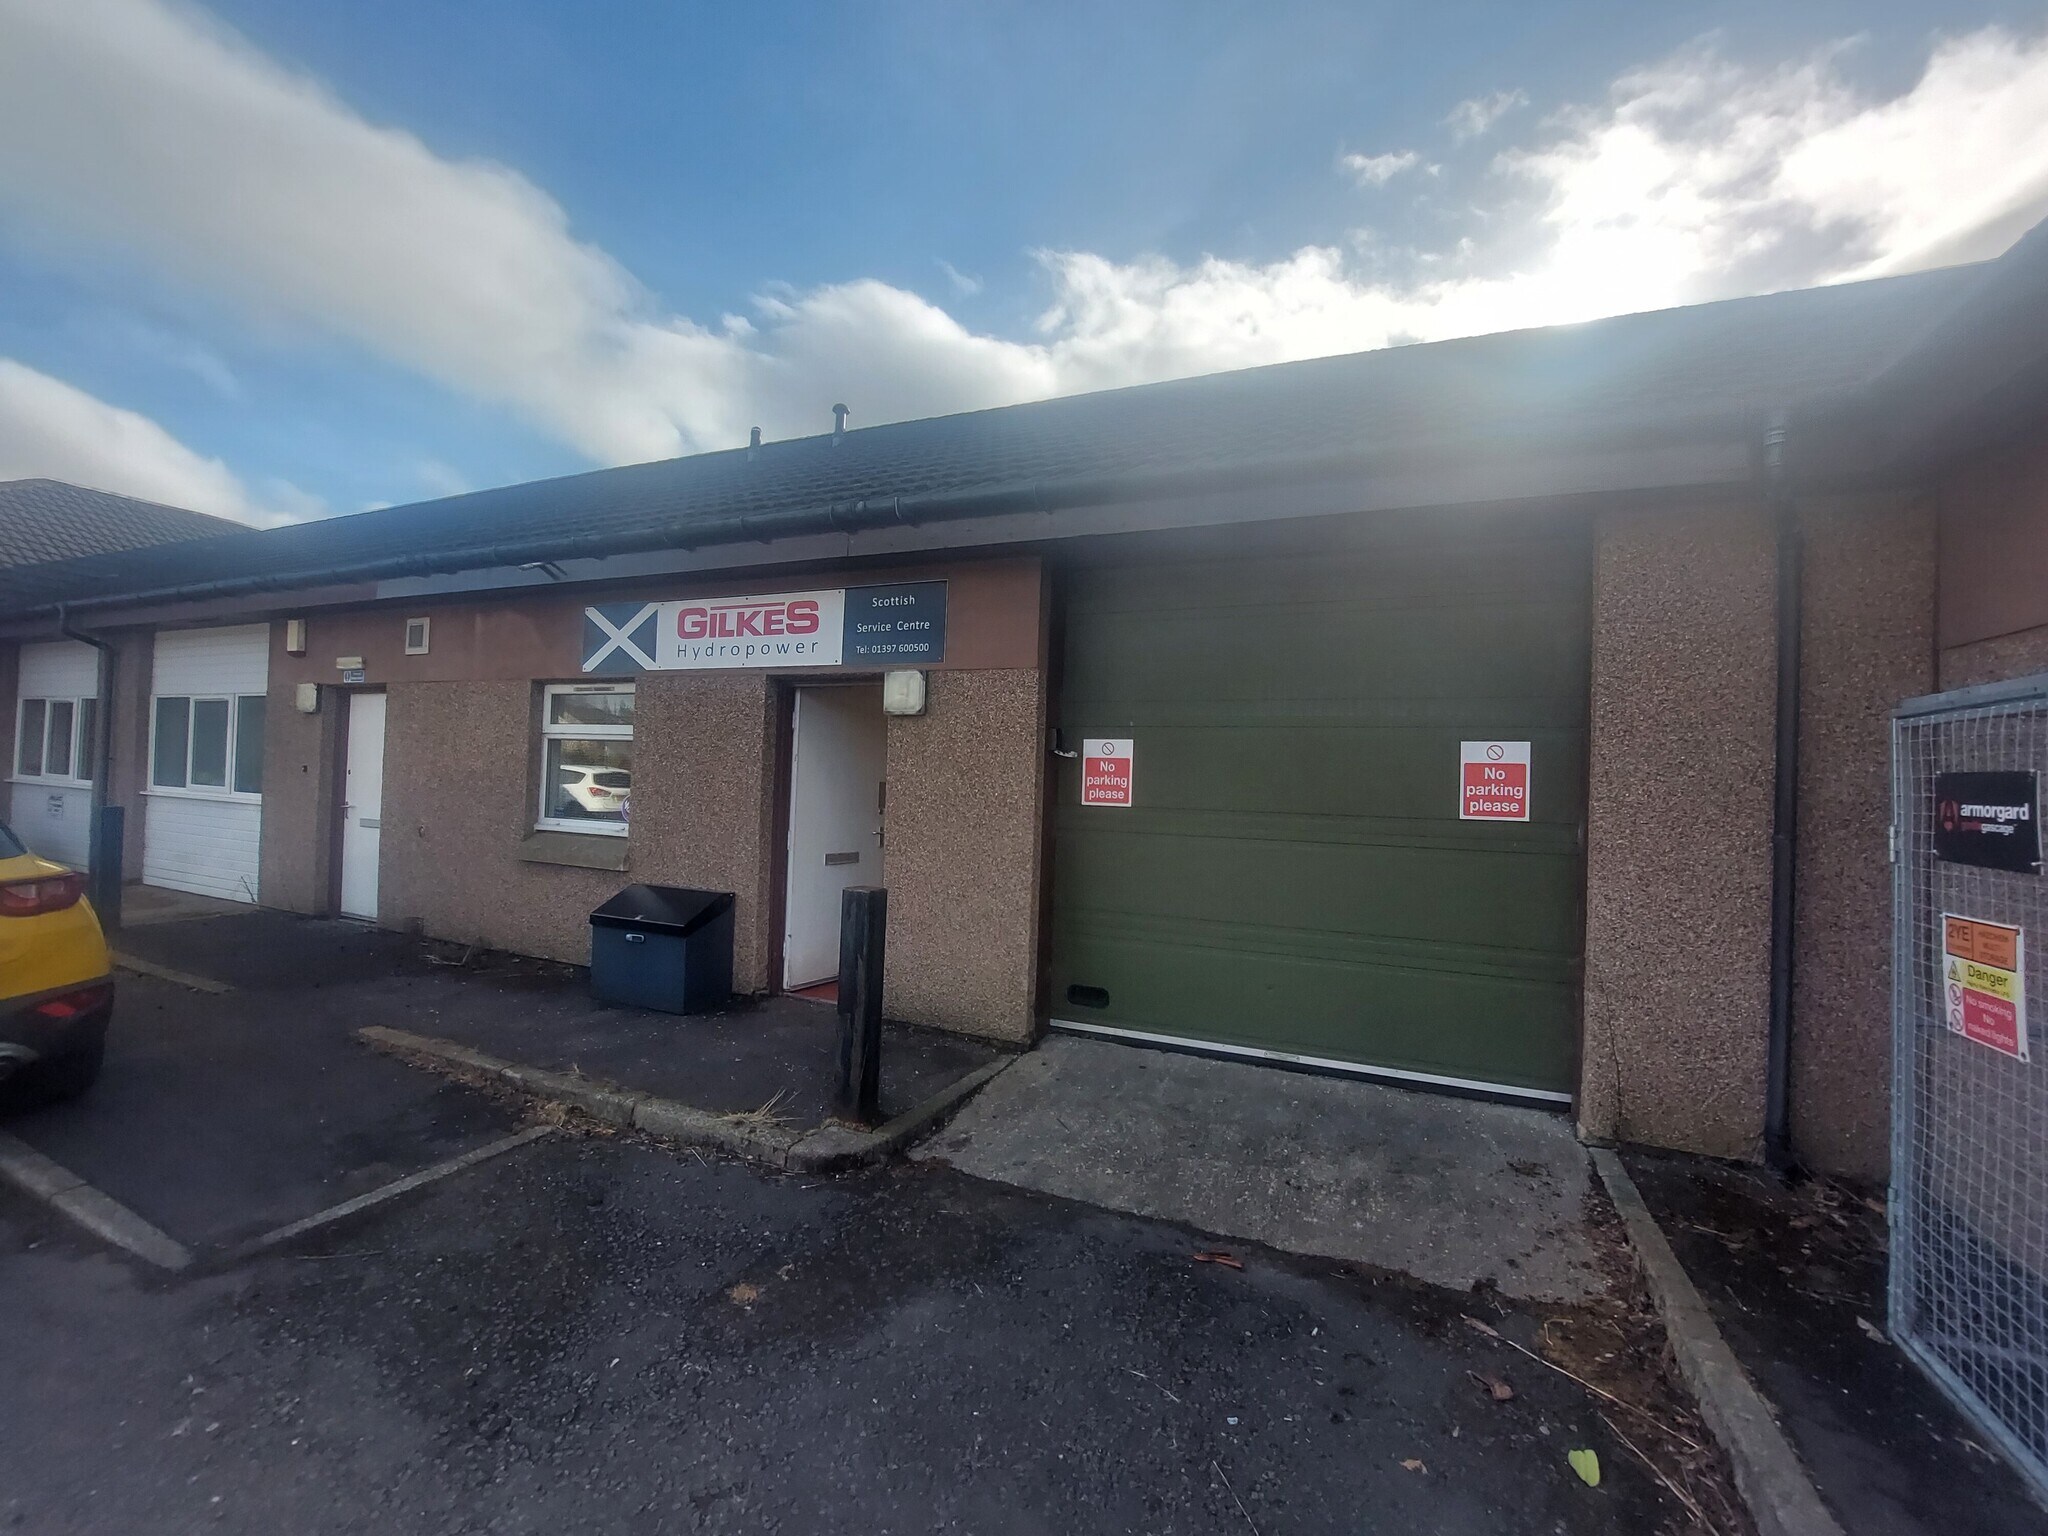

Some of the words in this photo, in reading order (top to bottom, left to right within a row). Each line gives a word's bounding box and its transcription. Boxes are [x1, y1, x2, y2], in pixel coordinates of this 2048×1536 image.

[872, 594, 915, 607] Scottish
[676, 600, 820, 640] GILKES
[856, 622, 892, 633] Service
[896, 620, 930, 631] Centre
[677, 641, 819, 661] Hydropower
[856, 645, 870, 654] Tel:
[871, 644, 896, 654] 01397
[898, 643, 929, 653] 600500
[1100, 760, 1115, 772] No
[1484, 767, 1506, 780] No
[1086, 774, 1128, 788] parking
[1089, 788, 1125, 800] please
[1466, 783, 1523, 799] parking
[1469, 799, 1520, 814] please
[1960, 803, 2030, 822] armorgard
[1967, 964, 2009, 987] Danger
[1965, 994, 1978, 1006] No
[1978, 1000, 2013, 1021] smoking
[1982, 1013, 1996, 1026] No
